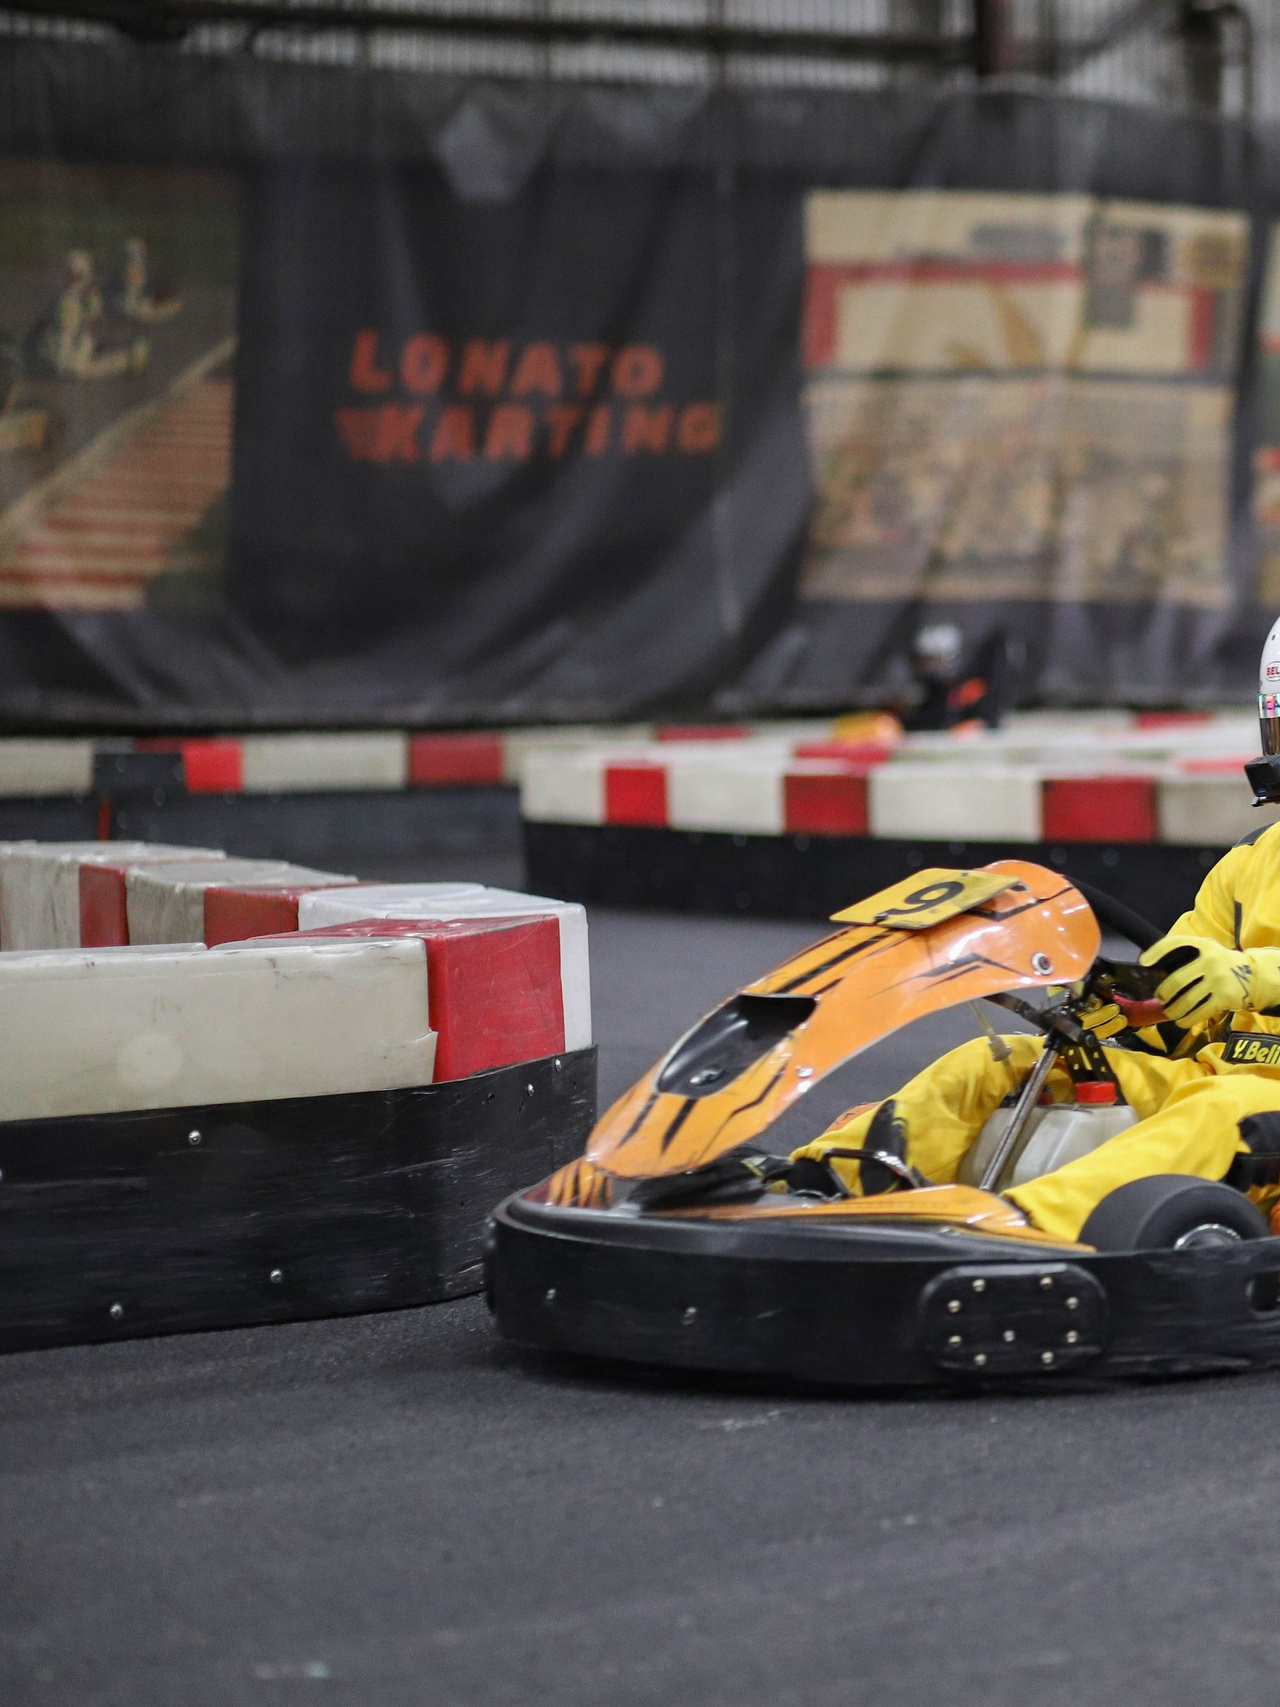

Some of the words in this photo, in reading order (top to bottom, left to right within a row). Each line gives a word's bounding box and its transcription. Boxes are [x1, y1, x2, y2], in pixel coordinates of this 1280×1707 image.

[349, 329, 665, 398] LONATO
[366, 402, 724, 464] KARTING
[886, 881, 964, 916] 9
